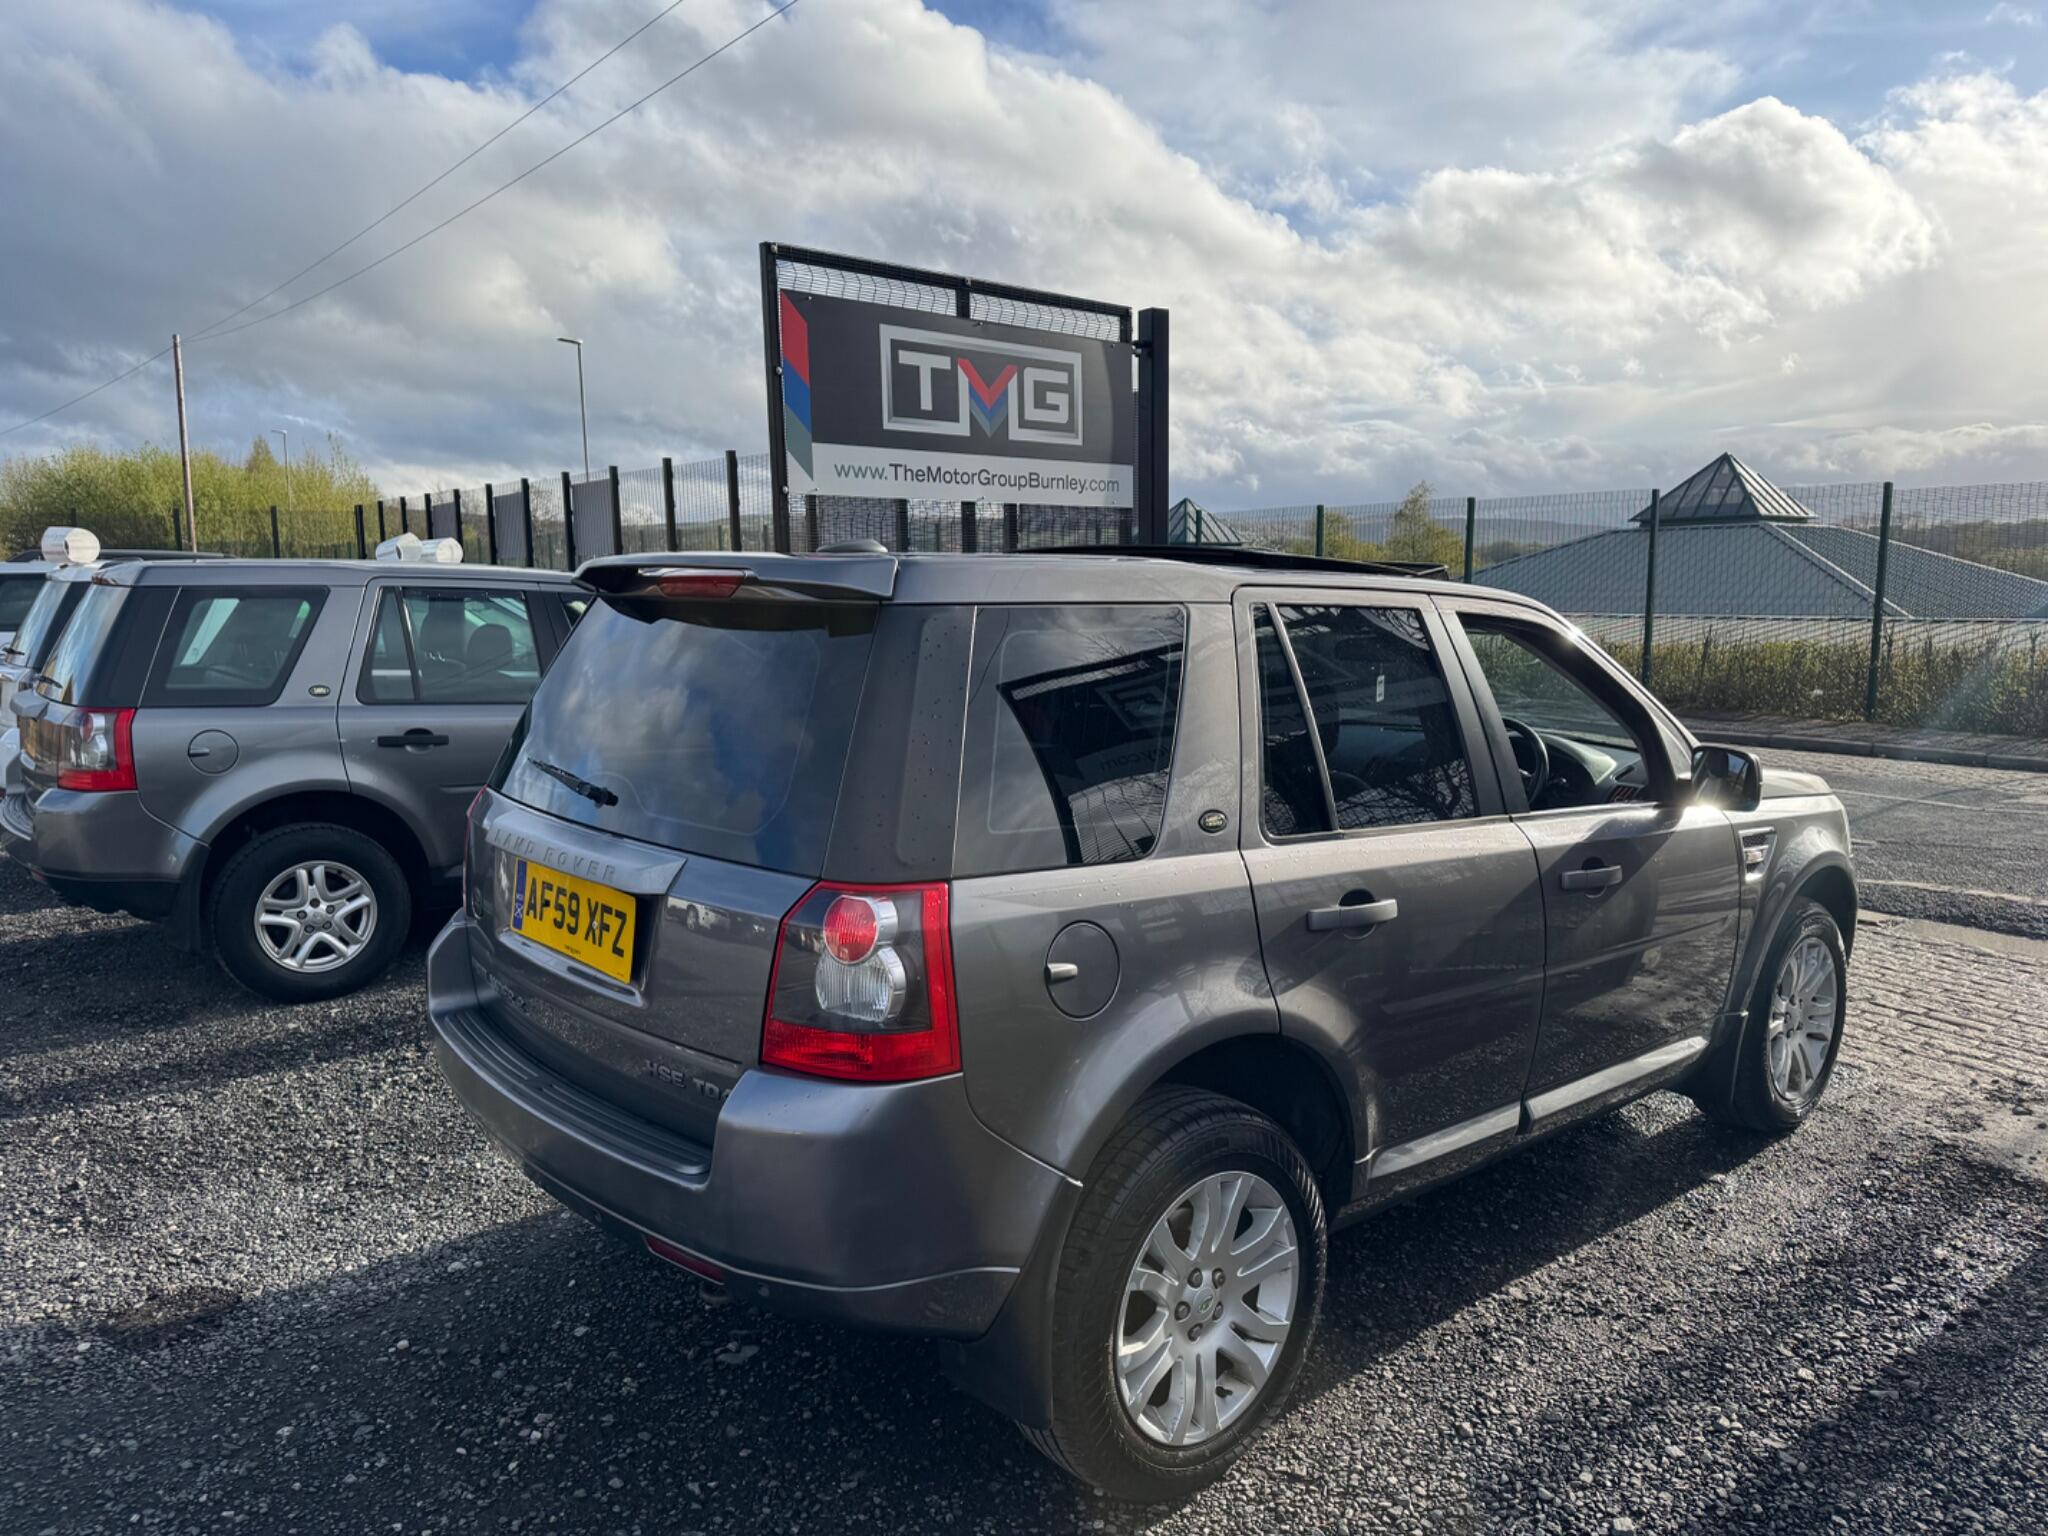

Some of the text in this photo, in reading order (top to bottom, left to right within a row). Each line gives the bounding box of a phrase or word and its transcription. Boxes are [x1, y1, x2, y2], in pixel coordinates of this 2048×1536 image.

[898, 350, 1069, 437] TMG
[834, 463, 1119, 494] www.TheMotorGroupBurnley.com
[494, 829, 617, 882] LAND ROVER
[526, 877, 628, 959] AF59 XFZ
